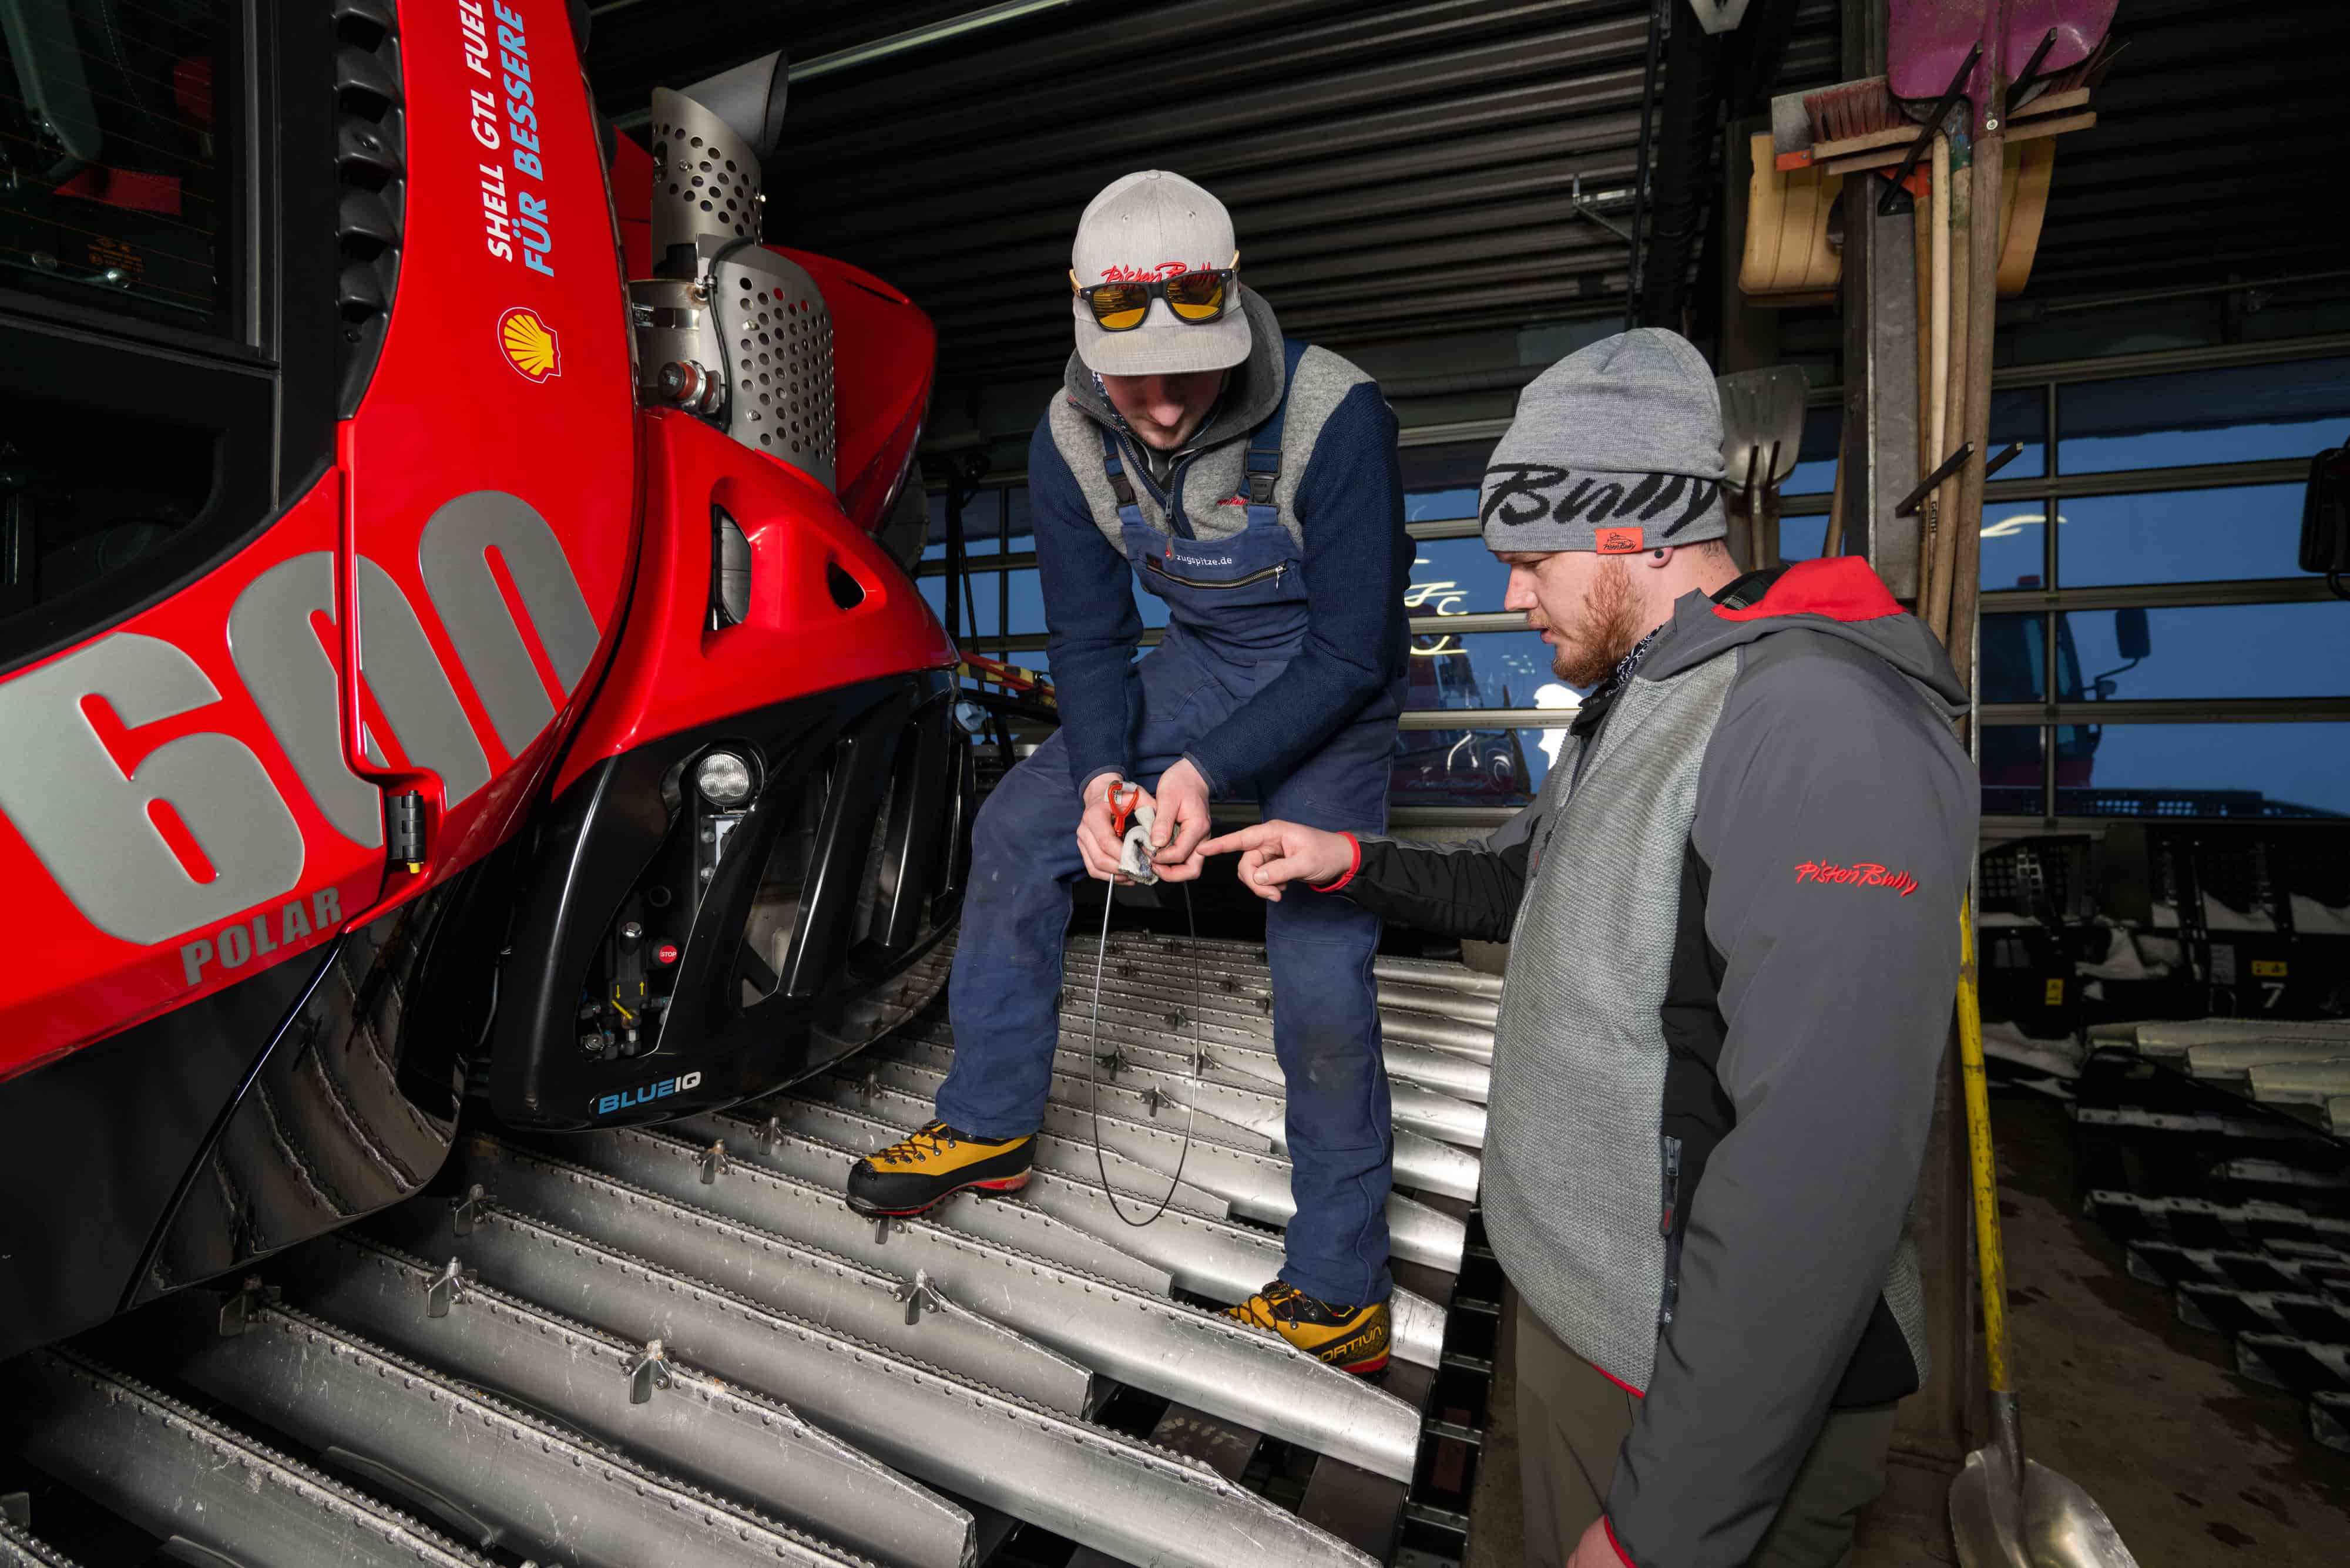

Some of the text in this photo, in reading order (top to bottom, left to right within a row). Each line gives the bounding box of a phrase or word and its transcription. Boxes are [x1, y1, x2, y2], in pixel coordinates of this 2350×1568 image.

[458, 0, 513, 262] SHELL GTL FUEL
[493, 0, 555, 278] FÜR BESSERE
[1480, 463, 1718, 538] Bully
[1176, 554, 1232, 566] zugspitze.de
[0, 489, 602, 946] 600
[1795, 859, 1918, 897] PistenBully
[180, 887, 343, 986] POLAR
[2261, 982, 2285, 1009] 7
[1316, 1325, 1382, 1364] ORTIVA
